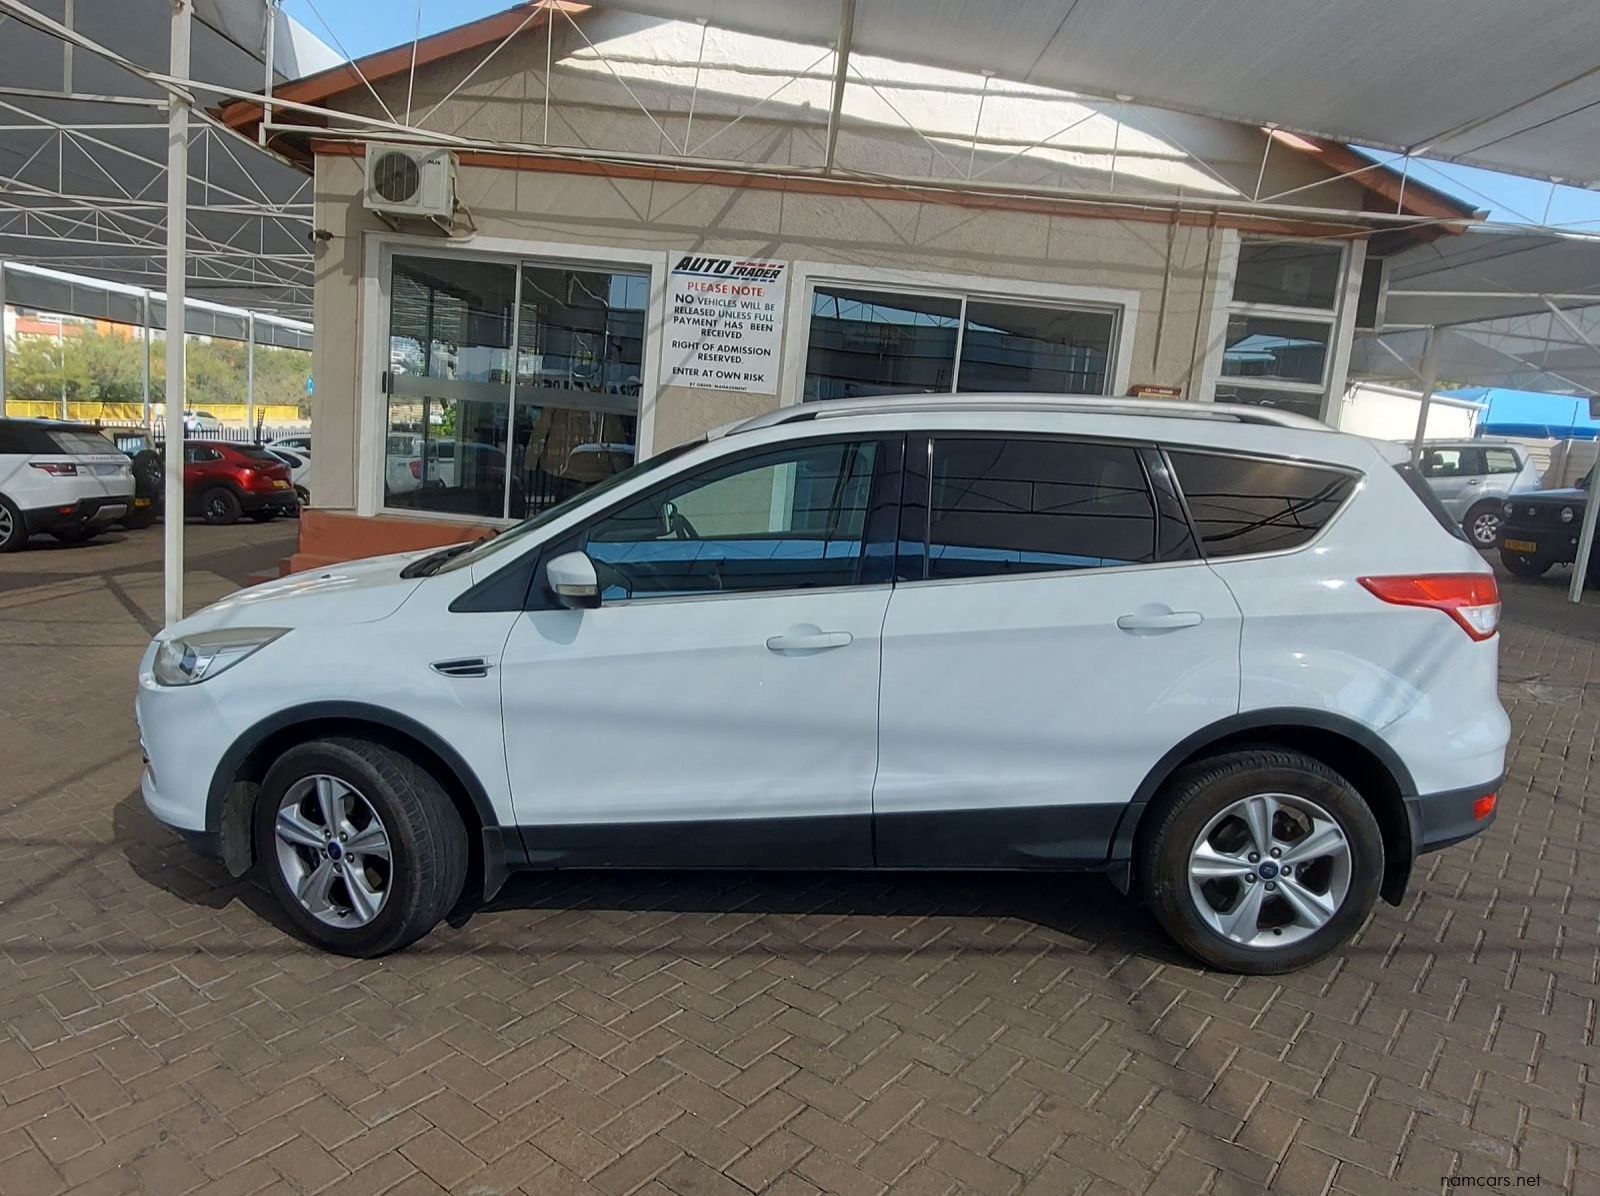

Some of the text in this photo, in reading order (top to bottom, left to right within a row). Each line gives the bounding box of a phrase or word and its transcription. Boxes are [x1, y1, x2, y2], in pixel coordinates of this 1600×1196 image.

[674, 256, 732, 274] AUTO
[729, 265, 782, 279] TRADER
[687, 281, 727, 294] PLEASE
[675, 293, 775, 311] NO VEHICLES WILL BE
[674, 306, 774, 322] RELEASED UNLESS FULL
[673, 316, 773, 332] PAYMENT HAS BEEN
[701, 328, 742, 339] RECEIVED
[671, 340, 771, 356] RIGHT OF ADMISSION
[672, 366, 764, 382] ENTER AT OWN RISK
